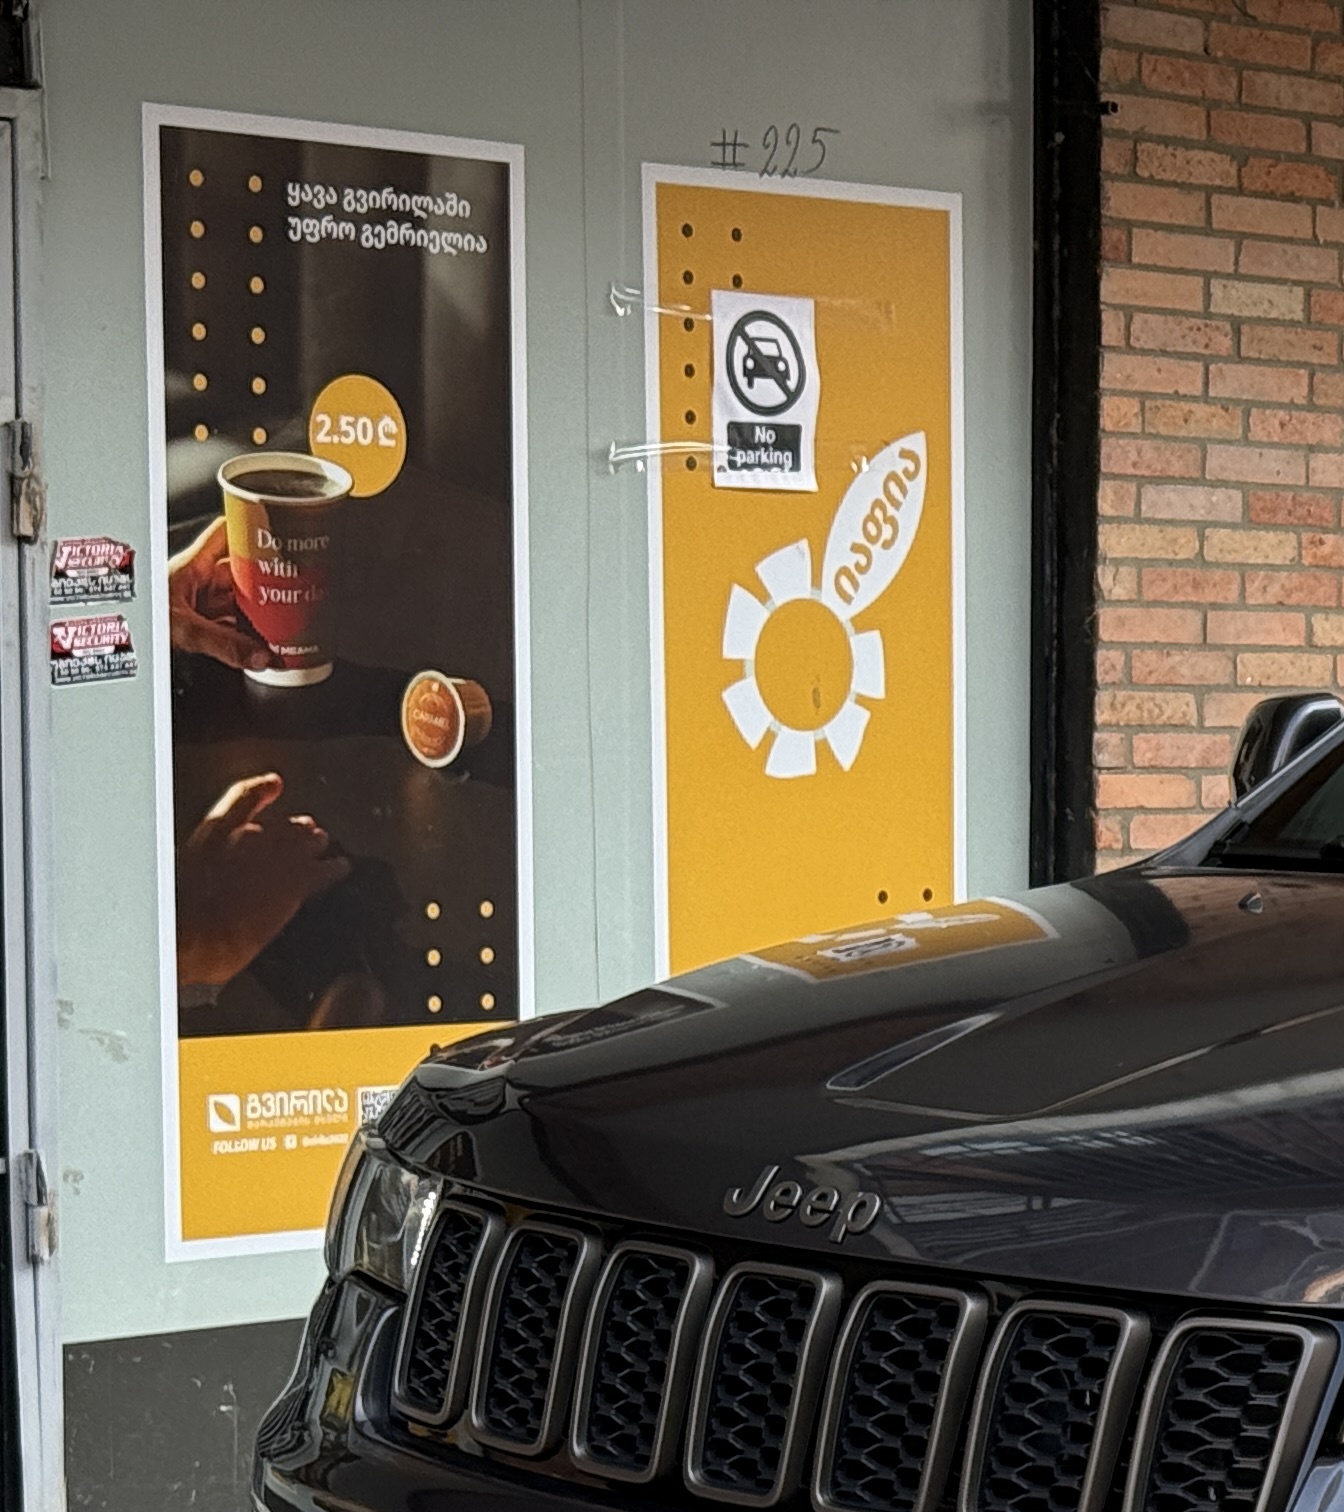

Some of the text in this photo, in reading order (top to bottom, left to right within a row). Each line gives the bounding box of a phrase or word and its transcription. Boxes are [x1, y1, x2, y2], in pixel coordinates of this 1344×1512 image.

[710, 122, 841, 178] #225
[286, 182, 472, 219] ყავა გვირილაში
[287, 214, 488, 256] უფრო გემრიელია
[754, 425, 776, 444] No
[736, 447, 793, 467] parking
[257, 527, 330, 551] Do more
[833, 447, 921, 606] იაფია
[259, 585, 302, 606] your
[53, 620, 129, 649] VICTORIA
[213, 1136, 277, 1155] FOLLOW US
[723, 1164, 883, 1243] Jeep
